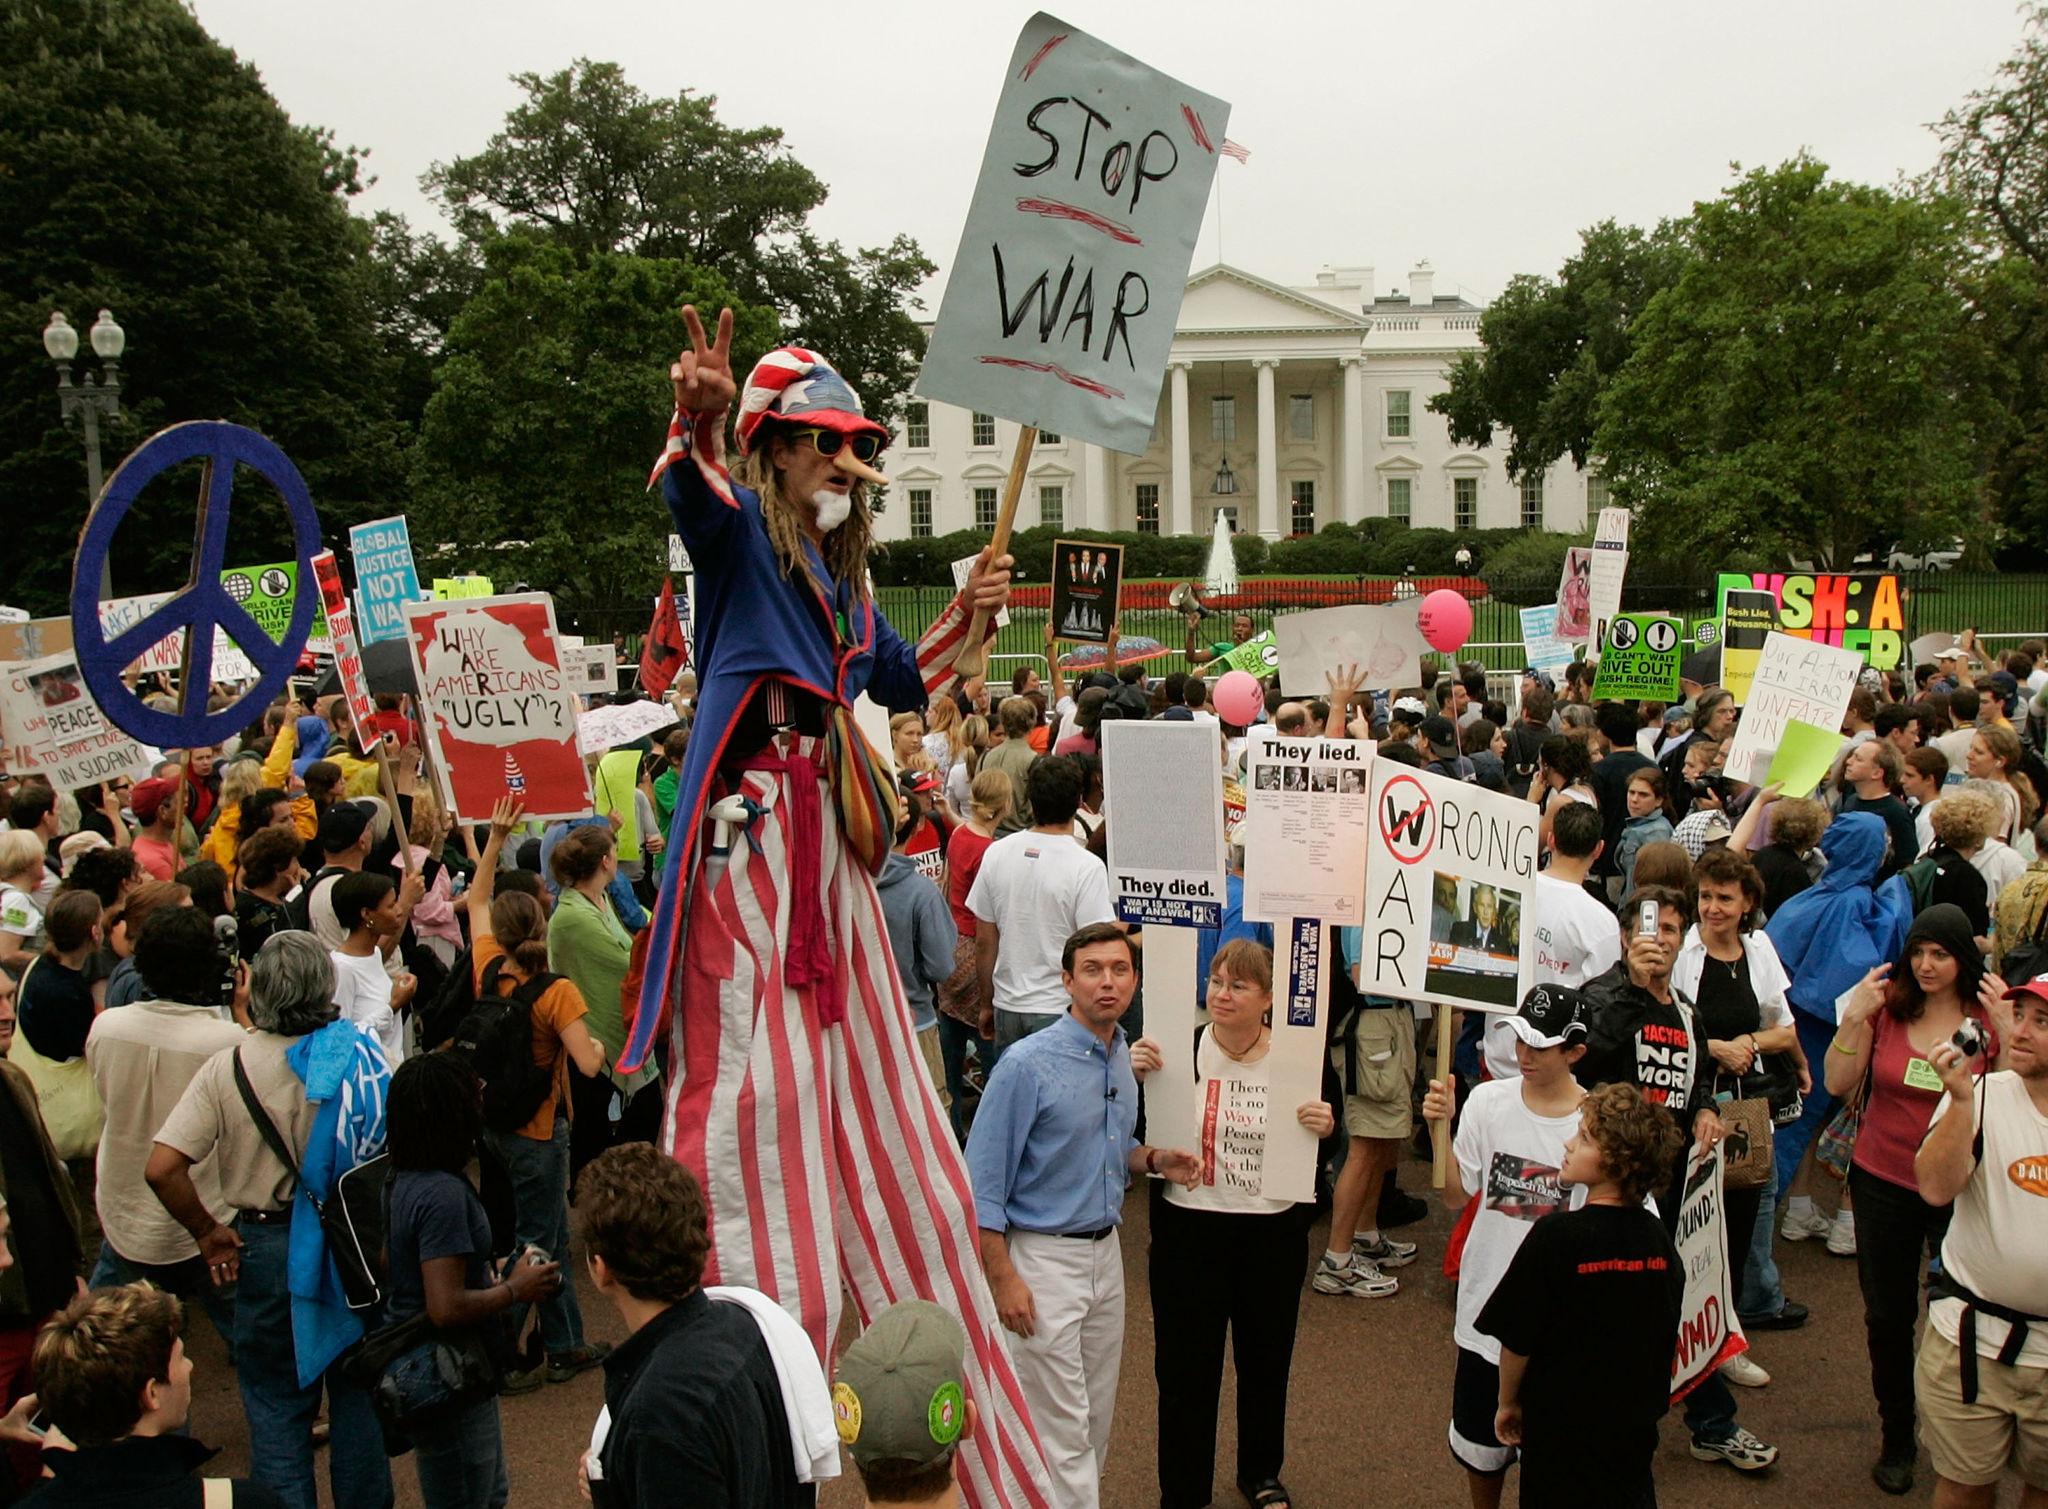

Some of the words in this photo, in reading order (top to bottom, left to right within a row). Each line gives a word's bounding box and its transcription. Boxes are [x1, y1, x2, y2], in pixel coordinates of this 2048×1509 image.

[992, 241, 1150, 373] WAR
[353, 529, 407, 555] GLOBAL
[358, 551, 410, 576] JUSTICE
[367, 571, 406, 600] NOT
[253, 607, 292, 622] RIVE
[371, 601, 403, 628] WA
[1869, 576, 1903, 631] A
[262, 621, 285, 631] USH
[1727, 618, 1773, 630] Thousands
[441, 627, 486, 654] WHY
[1765, 637, 1795, 666] Our
[461, 648, 503, 673] ARE
[1615, 651, 1646, 661] CAN'T
[1649, 653, 1675, 663] WAIT
[1638, 661, 1675, 676] OUT
[433, 670, 561, 697] AMERICANS
[1626, 675, 1674, 686] REGIME!
[1762, 666, 1788, 683] IN
[1796, 676, 1842, 702] IRAQ
[49, 705, 99, 736] PEACE
[1756, 690, 1835, 727] UNFAIR
[1750, 717, 1778, 742] UN
[40, 751, 58, 765] TO
[61, 741, 92, 759] SAVE
[57, 768, 77, 785] IN
[78, 743, 142, 779] SUDAN?
[1262, 741, 1312, 763] They
[1318, 744, 1361, 761] lied.
[1732, 748, 1757, 773] UN
[1118, 876, 1163, 898] They
[1168, 880, 1215, 897] died.
[1123, 905, 1143, 915] THE
[1145, 906, 1191, 919] ANSWER
[1126, 898, 1150, 907] WAR
[1152, 900, 1163, 908] IS
[1165, 900, 1187, 910] NOT
[1301, 922, 1311, 944] THE
[1309, 926, 1318, 951] WAR
[1298, 945, 1309, 995] ANSWER
[1308, 954, 1317, 966] IS
[1307, 968, 1316, 992] NOT
[1638, 1064, 1685, 1089] MOR
[1230, 1096, 1242, 1108] is
[1247, 1101, 1264, 1109] no
[1225, 1110, 1254, 1127] Way
[1224, 1125, 1266, 1141] Peace
[1223, 1141, 1264, 1156] Peace
[1225, 1157, 1236, 1170] is
[1240, 1158, 1261, 1171] the
[1497, 1171, 1536, 1192] Impeach
[1536, 1184, 1562, 1199] Bush.
[1676, 1189, 1715, 1248] OUND:
[1577, 1258, 1643, 1274] american
